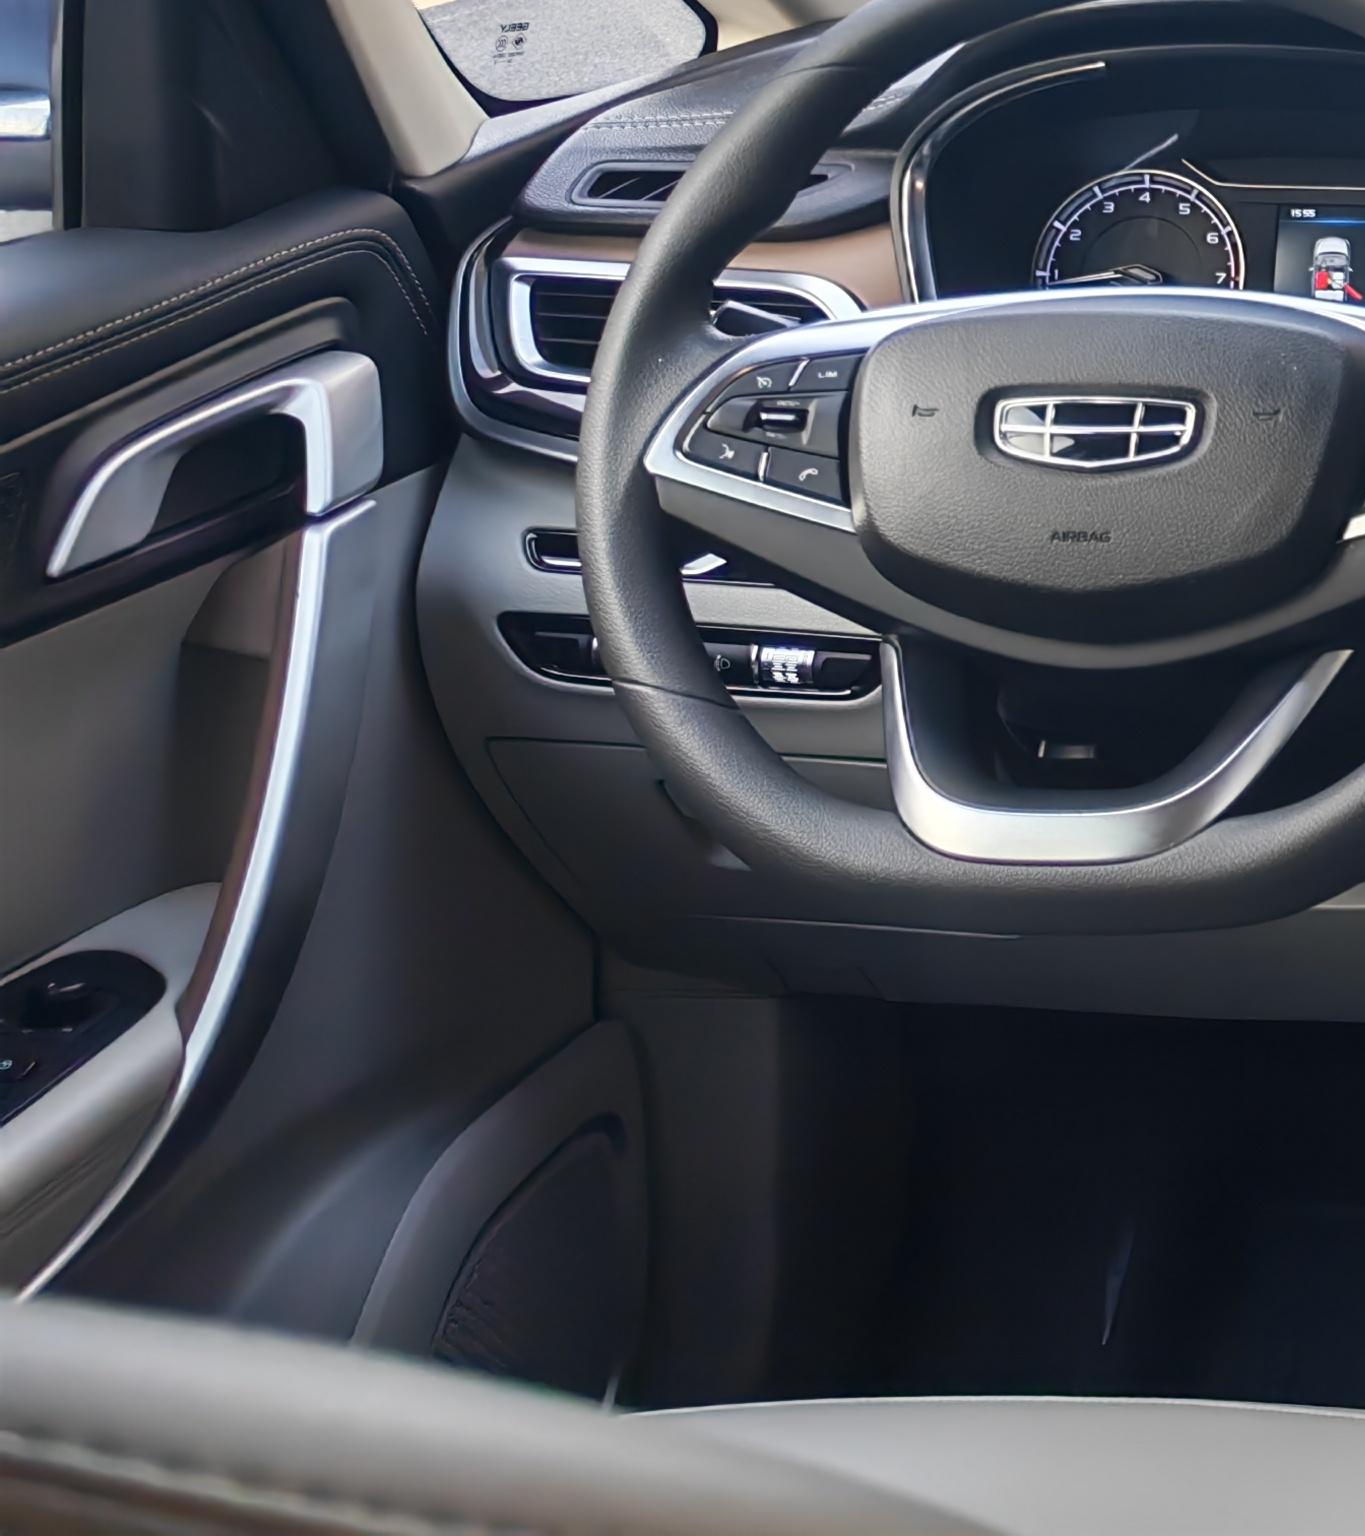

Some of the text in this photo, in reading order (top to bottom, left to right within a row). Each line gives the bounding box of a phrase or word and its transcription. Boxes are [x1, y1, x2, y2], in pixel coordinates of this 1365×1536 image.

[1139, 192, 1151, 204] 4
[1102, 202, 1115, 213] 3
[1178, 203, 1191, 215] 5
[1069, 229, 1082, 241] 2
[1206, 232, 1219, 244] 6
[1215, 272, 1227, 285] 7
[818, 371, 838, 379] LIM
[1050, 530, 1113, 544] AIRBAG
